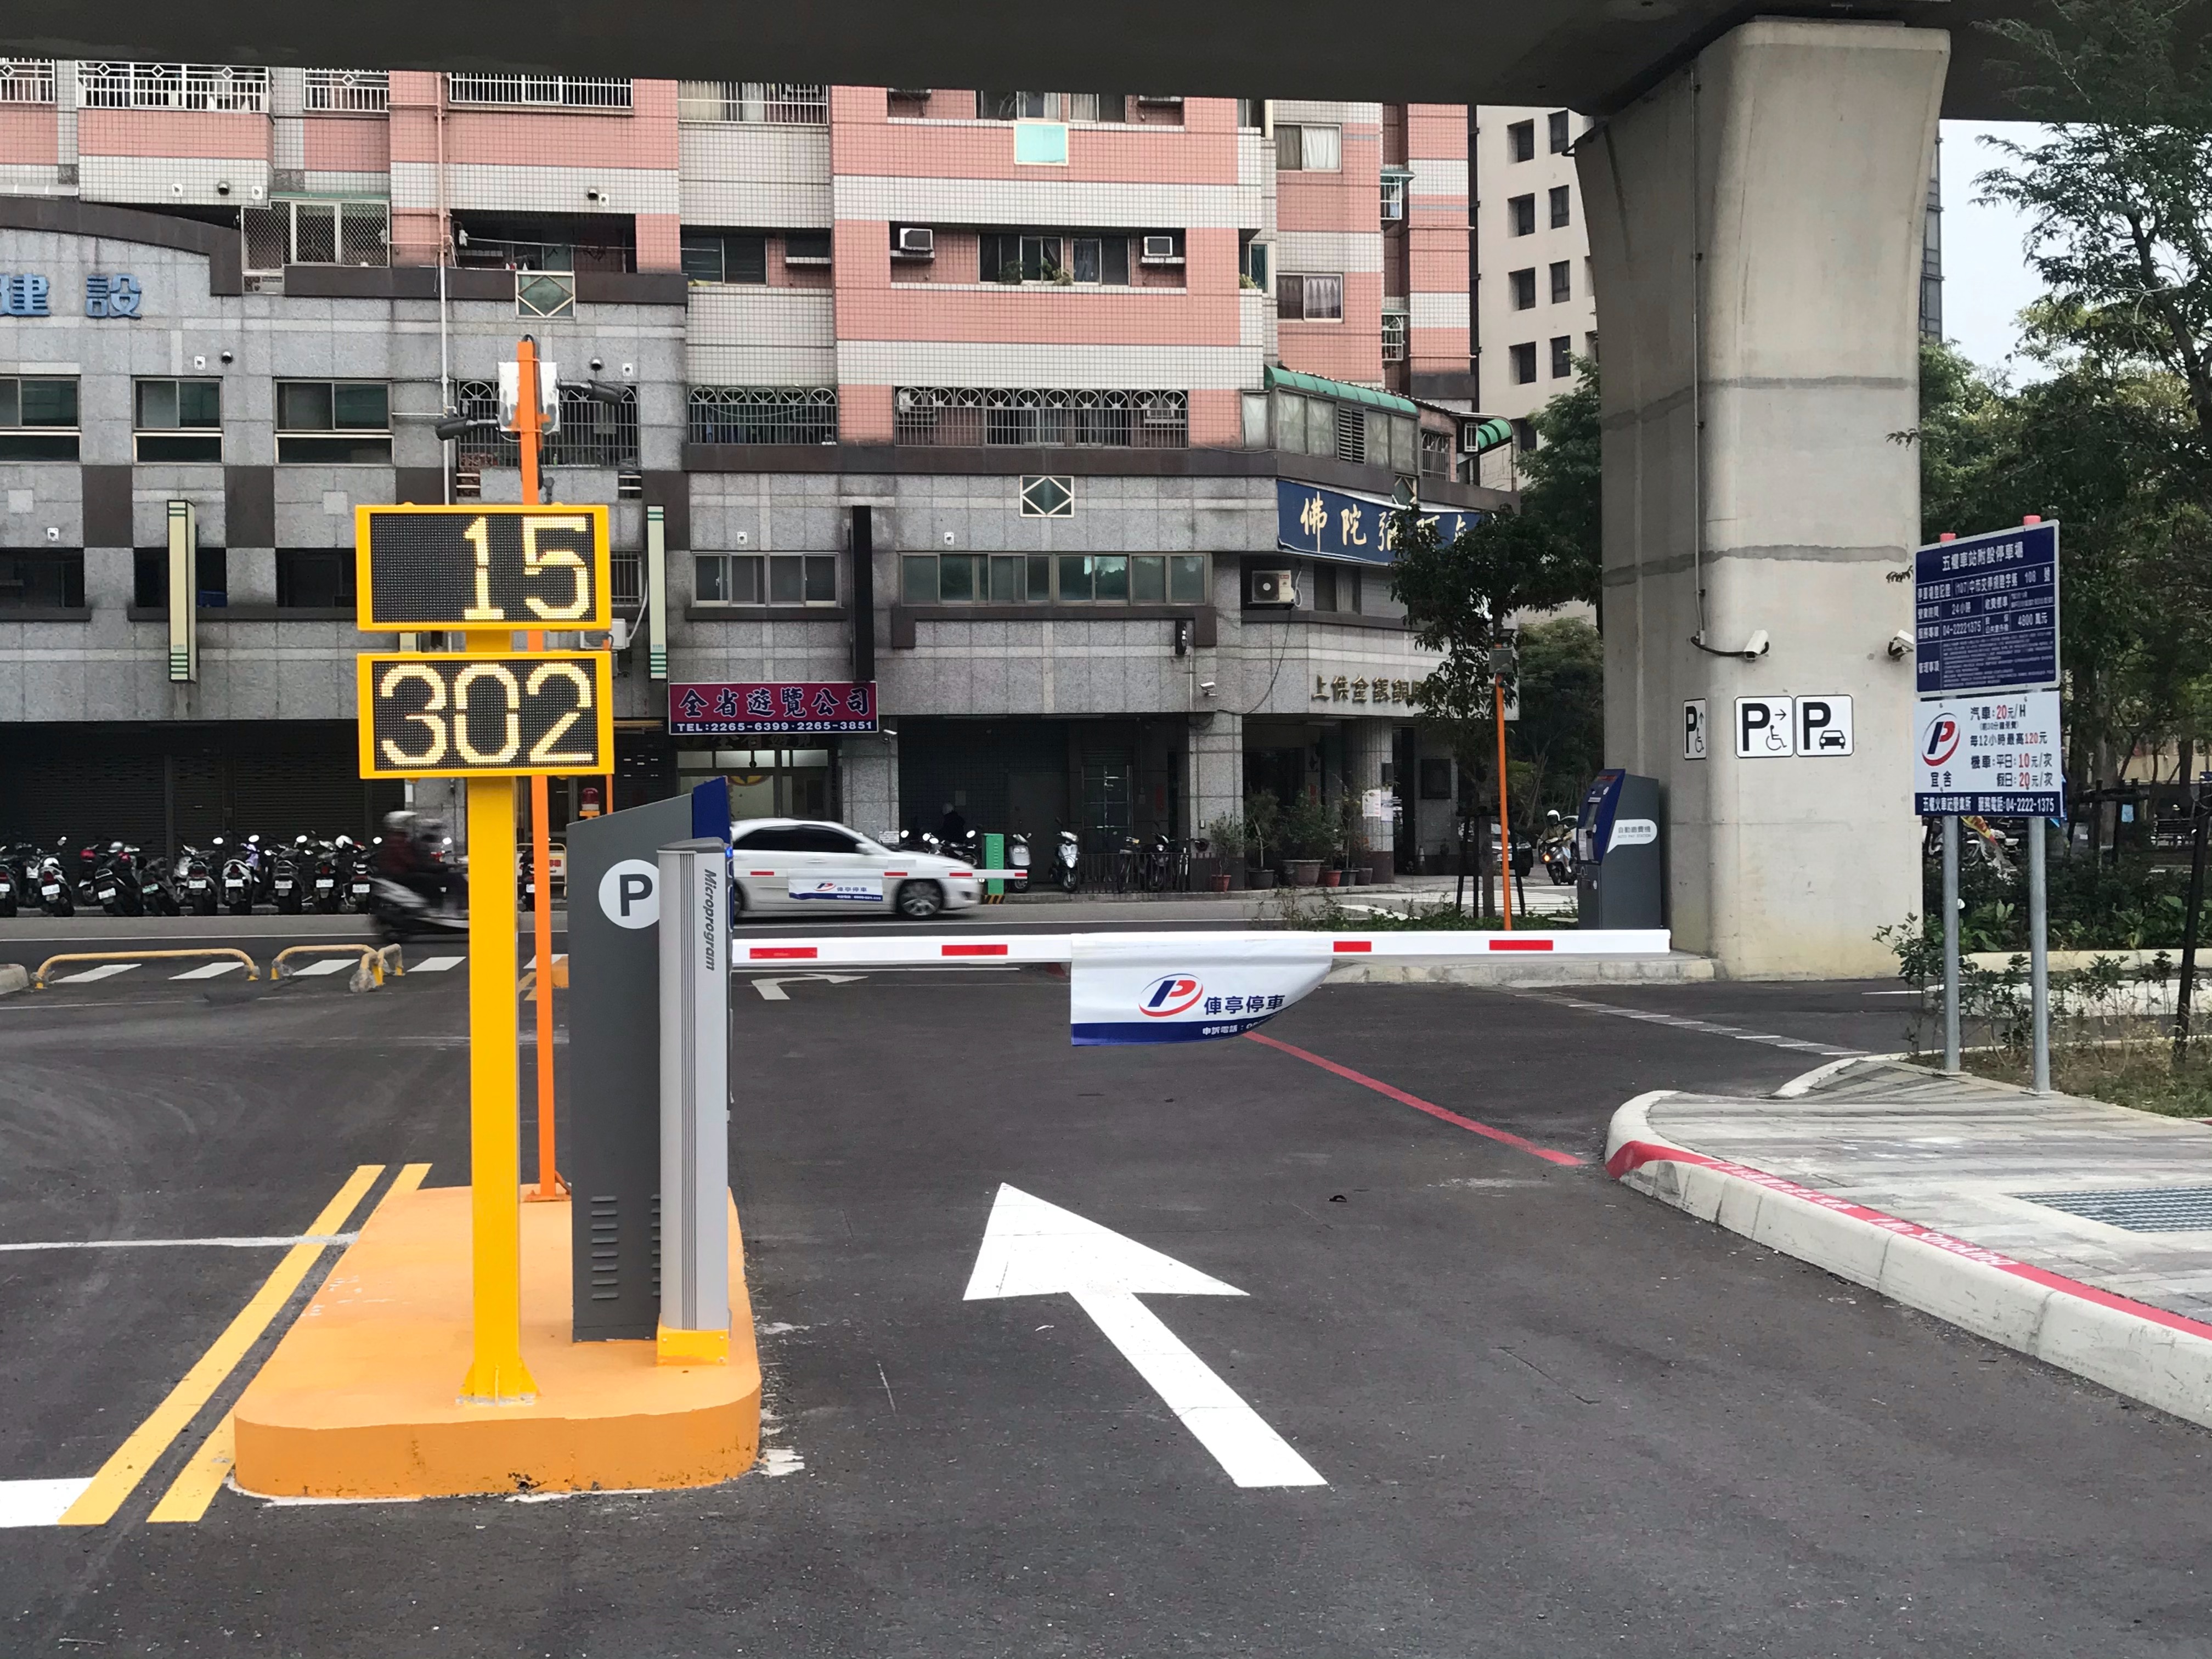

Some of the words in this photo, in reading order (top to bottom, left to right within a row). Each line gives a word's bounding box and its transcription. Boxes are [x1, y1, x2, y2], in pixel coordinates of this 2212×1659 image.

[463, 514, 590, 620] 15
[380, 663, 594, 765] 302
[678, 687, 871, 718] 全省遊覽公司
[1803, 702, 1831, 750] P
[1685, 705, 1697, 753] P
[1742, 703, 1770, 752] P
[618, 873, 654, 917] P
[703, 868, 717, 971] Microprogram
[1204, 994, 1285, 1015] 俥亭停車
[1908, 1232, 2019, 1266] Smoking
